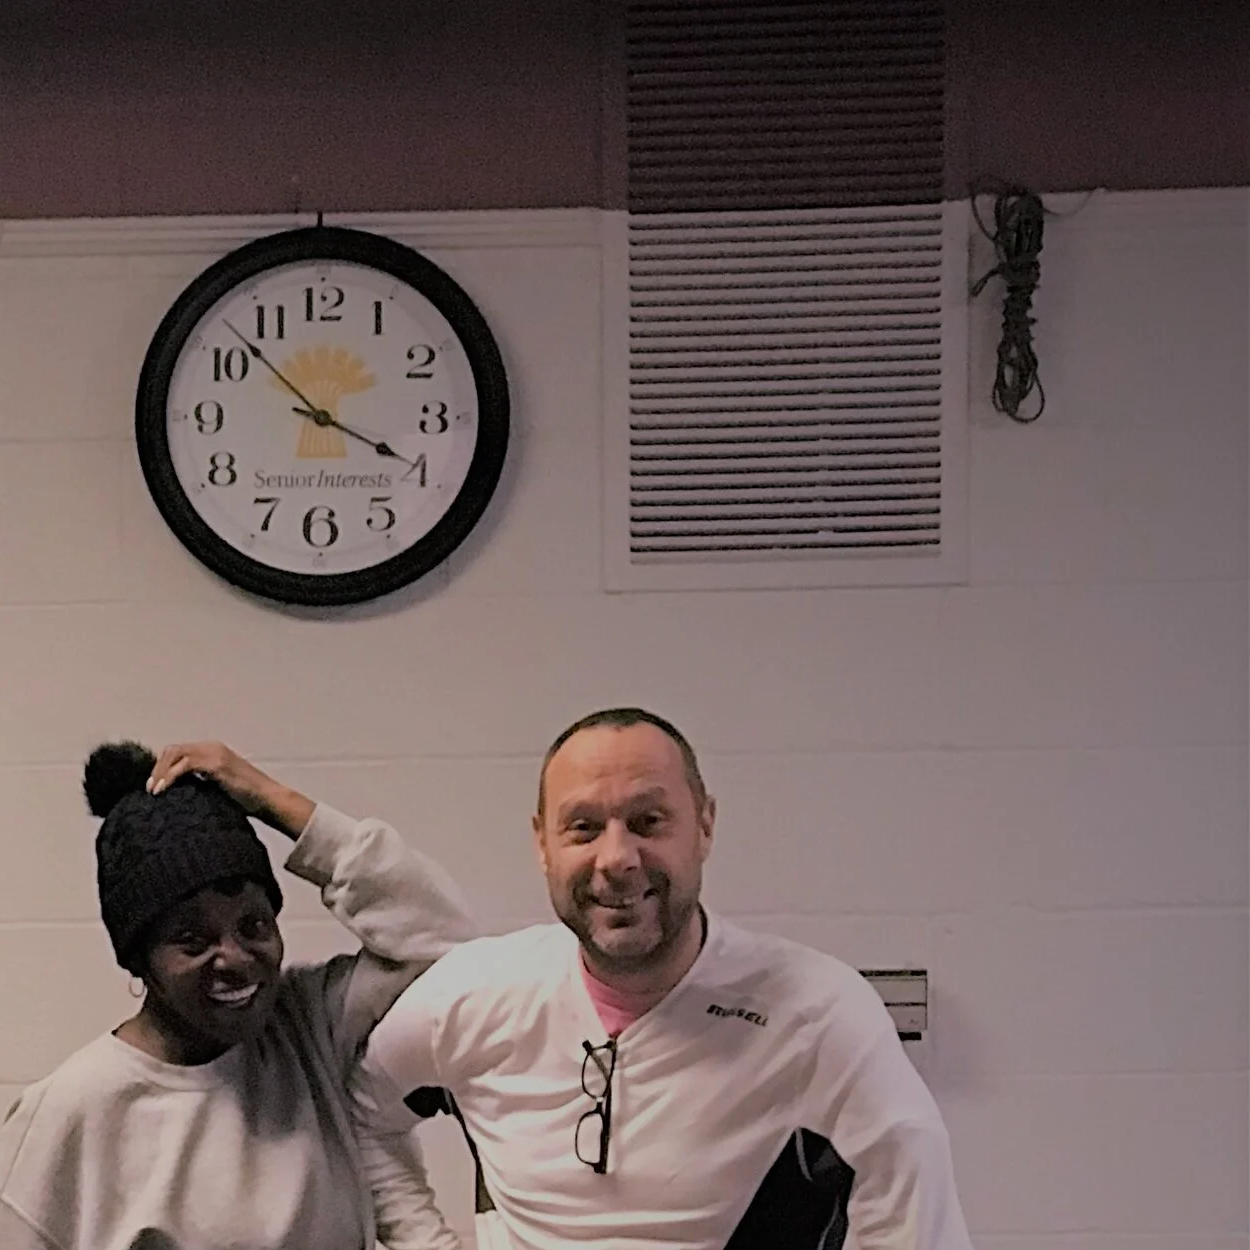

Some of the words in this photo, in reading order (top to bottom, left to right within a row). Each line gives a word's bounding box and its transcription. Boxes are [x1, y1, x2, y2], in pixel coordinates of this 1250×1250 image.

[256, 304, 285, 339] 11
[303, 286, 345, 322] 12
[373, 300, 383, 336] 1
[213, 346, 249, 382] 10
[406, 343, 436, 379] 2
[194, 400, 224, 434] 9
[419, 401, 448, 434] 3
[208, 451, 237, 486] 8
[401, 453, 427, 488] 4
[253, 496, 282, 532] 7
[302, 505, 339, 548] 6
[366, 495, 396, 531] 5
